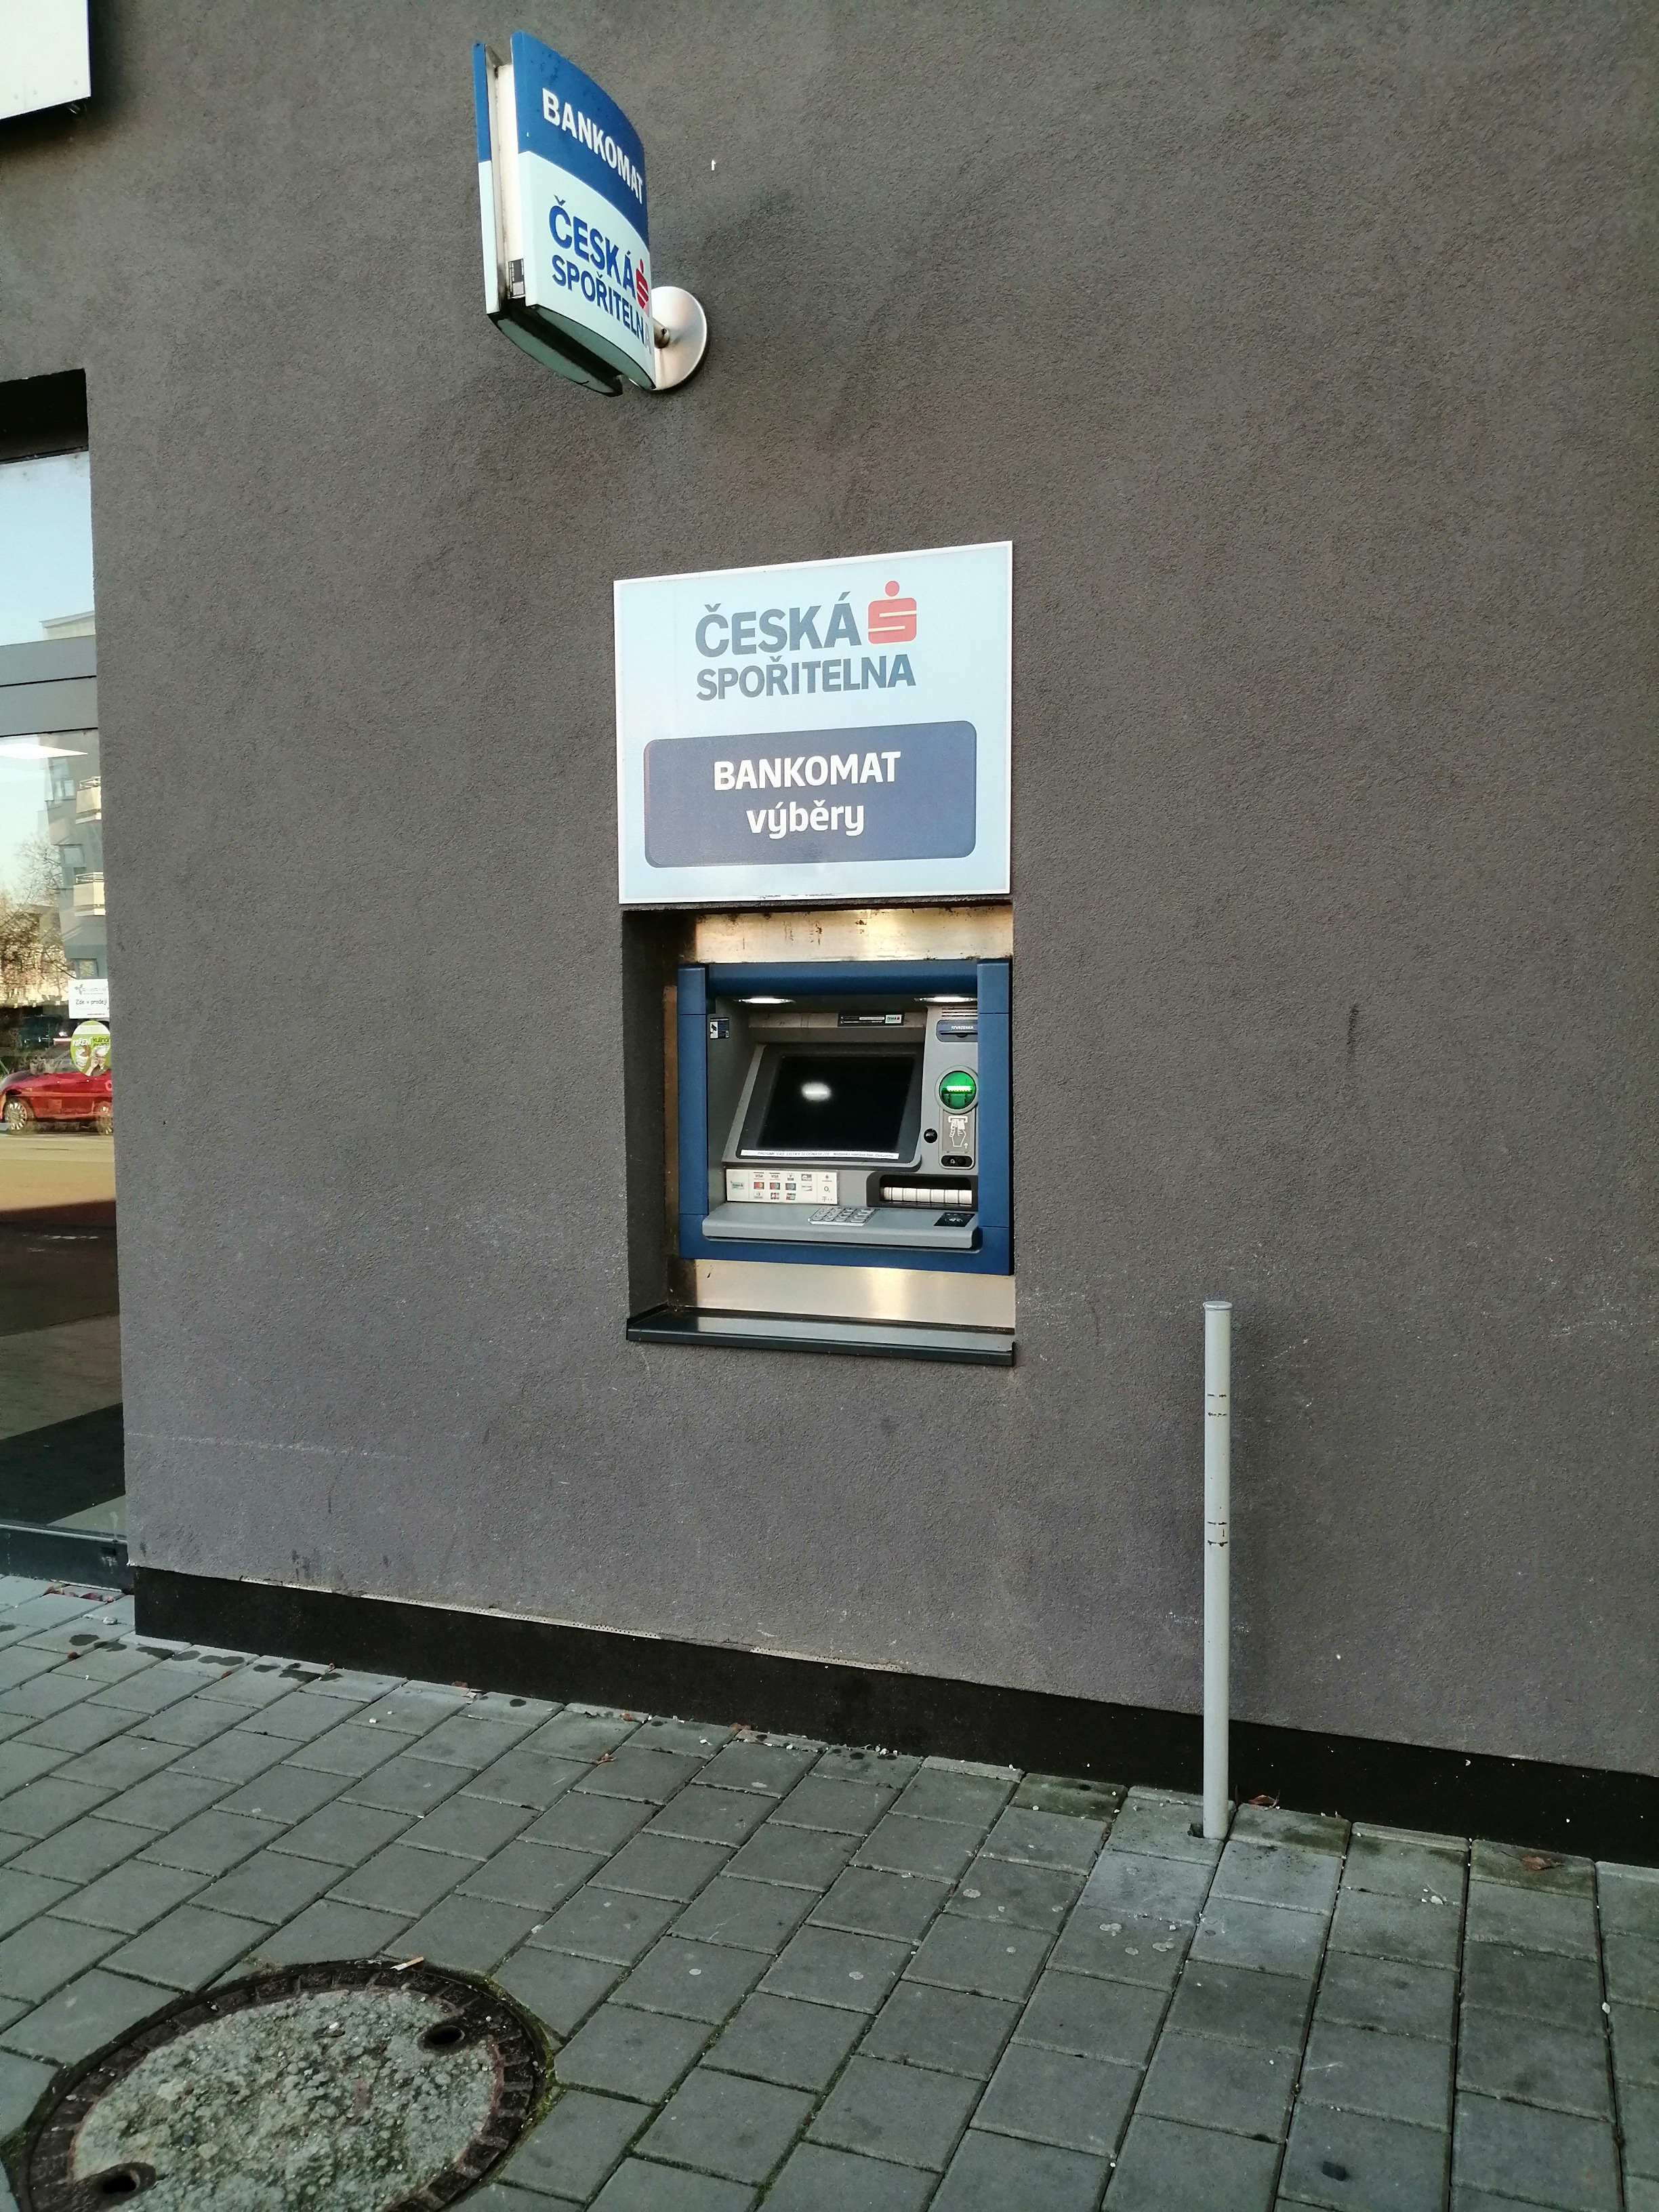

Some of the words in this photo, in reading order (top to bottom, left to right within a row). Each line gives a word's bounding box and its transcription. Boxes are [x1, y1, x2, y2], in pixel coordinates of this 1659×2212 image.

[542, 87, 643, 205] BANKOMAT
[548, 194, 636, 302] ČESKÁ
[552, 254, 652, 356] SPOŘITELNA
[695, 591, 862, 658] ČESKÁ
[696, 653, 917, 701] SPOŘITELNA
[713, 751, 901, 792] BANKOMAT
[746, 799, 865, 840] výběry
